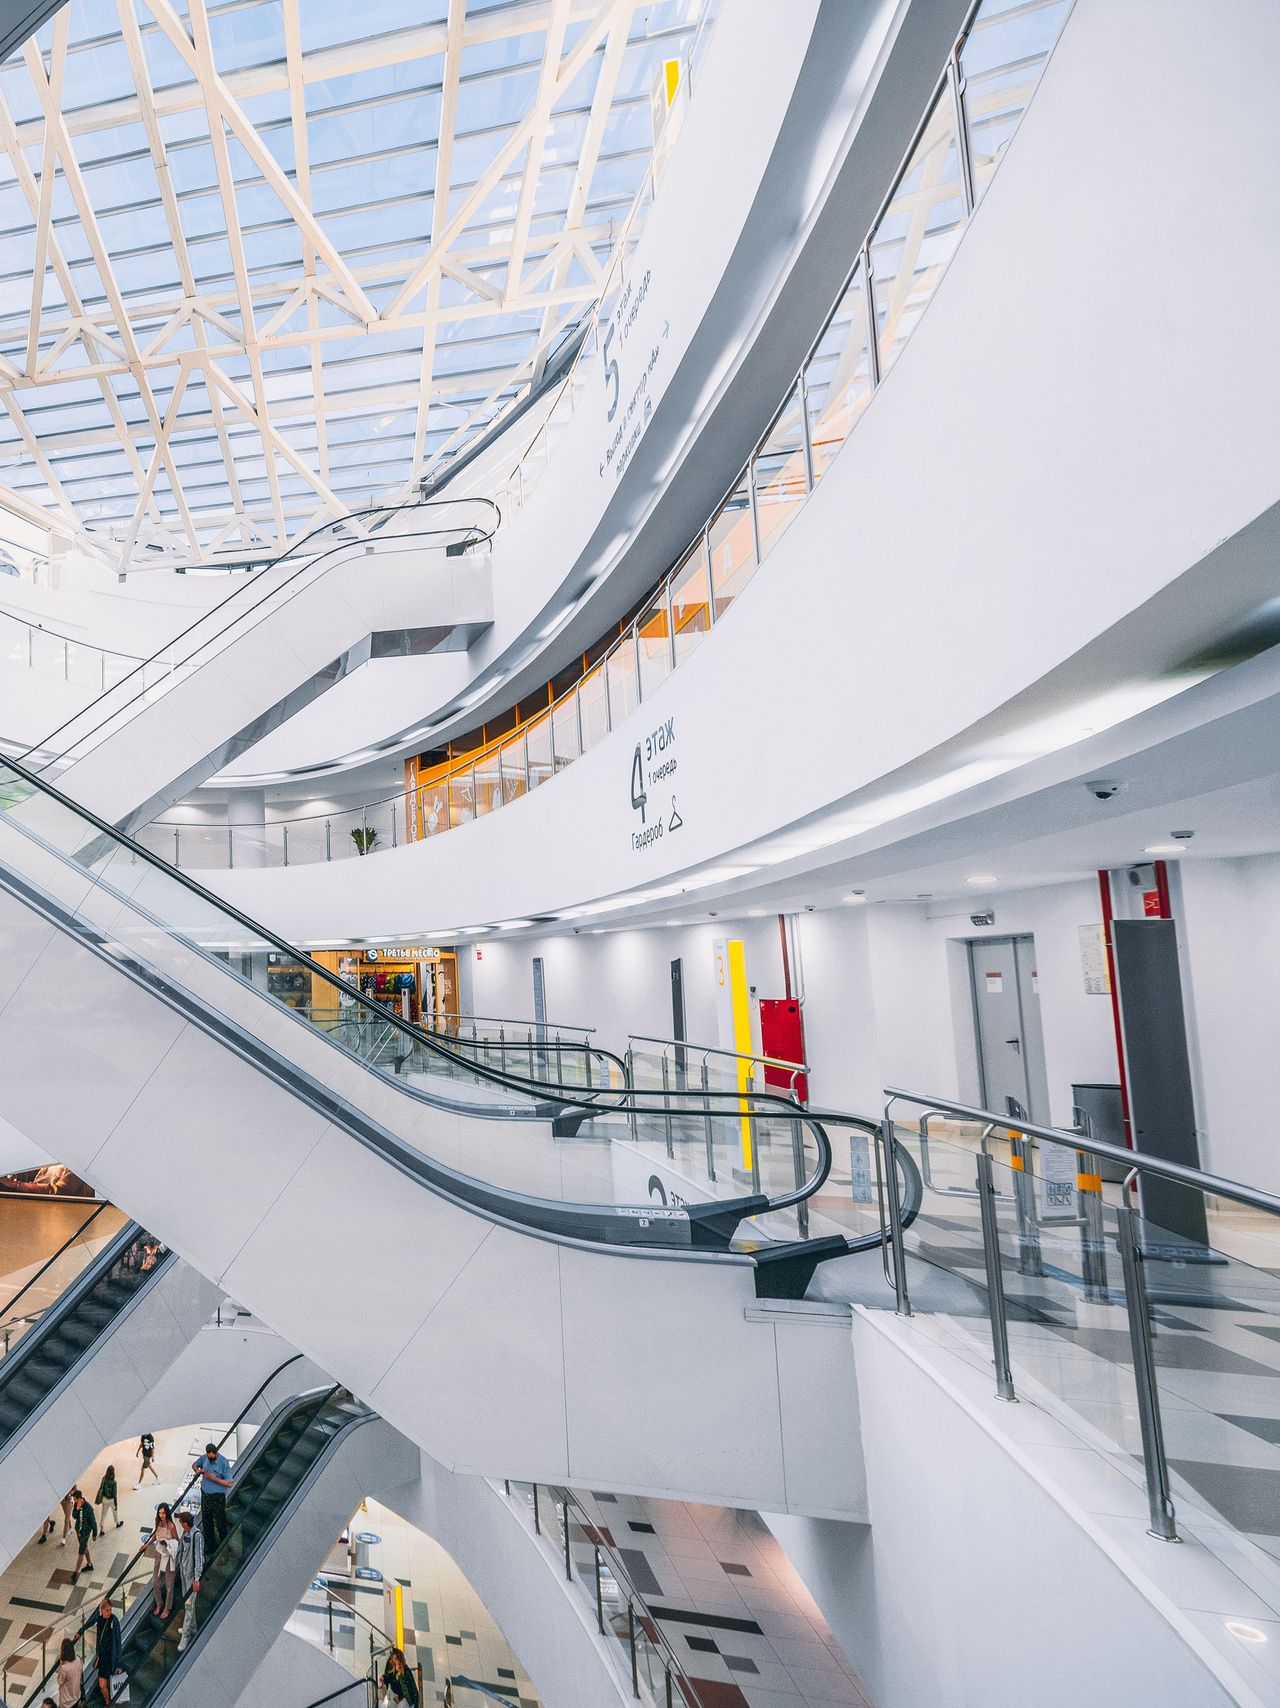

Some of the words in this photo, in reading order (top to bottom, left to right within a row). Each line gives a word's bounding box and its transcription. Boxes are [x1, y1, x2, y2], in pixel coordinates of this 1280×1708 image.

[624, 270, 651, 339] очередь
[603, 322, 620, 423] 5
[627, 372, 648, 421] сектор
[646, 716, 675, 761] этаж
[631, 742, 647, 824] 4
[653, 758, 678, 784] очередь
[631, 816, 663, 852] Гардероб
[383, 949, 410, 957] ТРЕТЬЕ
[716, 955, 725, 986] 3
[387, 1590, 391, 1604] 1
